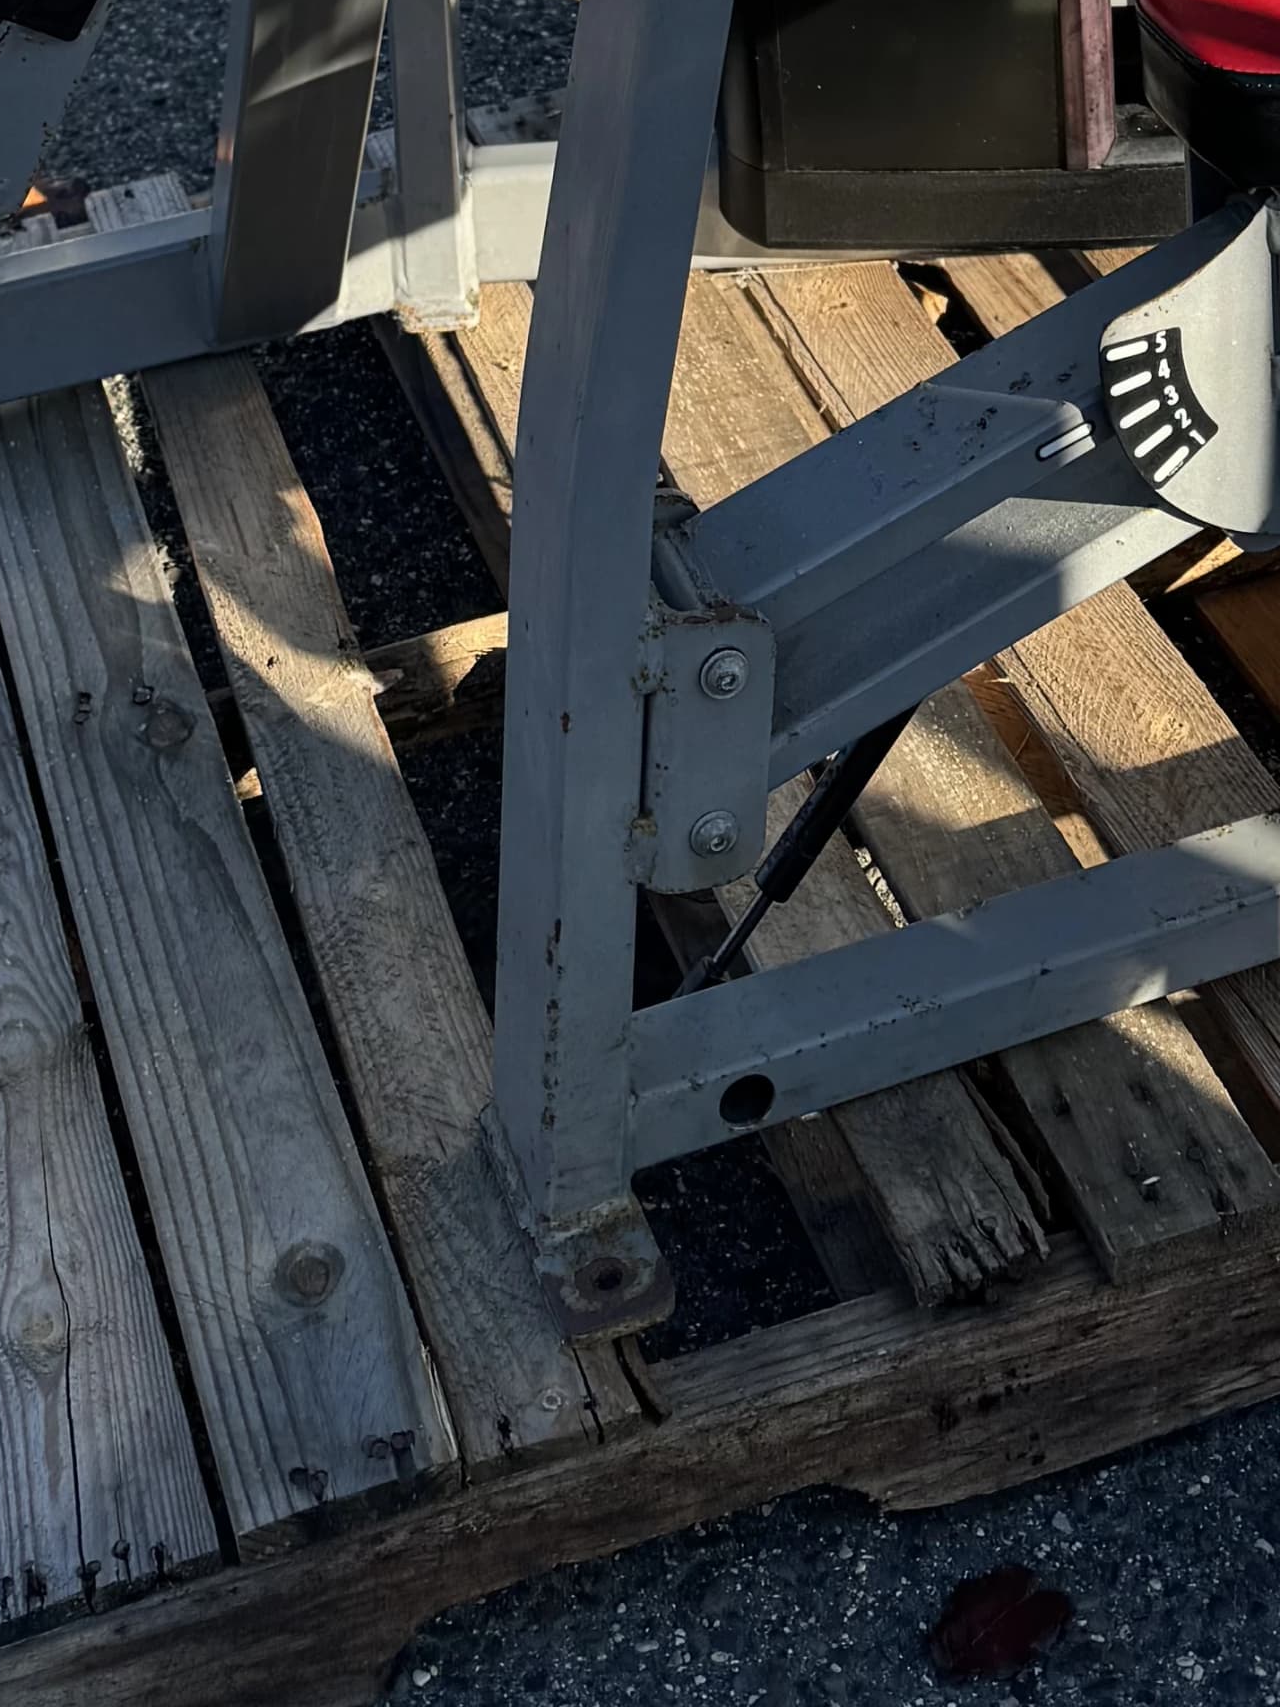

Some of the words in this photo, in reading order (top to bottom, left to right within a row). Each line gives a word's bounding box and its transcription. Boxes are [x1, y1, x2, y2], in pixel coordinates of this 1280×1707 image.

[1155, 330, 1167, 353] 5
[1158, 358, 1171, 379] 4
[1164, 385, 1180, 406] 3
[1174, 407, 1192, 429] 2
[1189, 429, 1206, 445] 1
